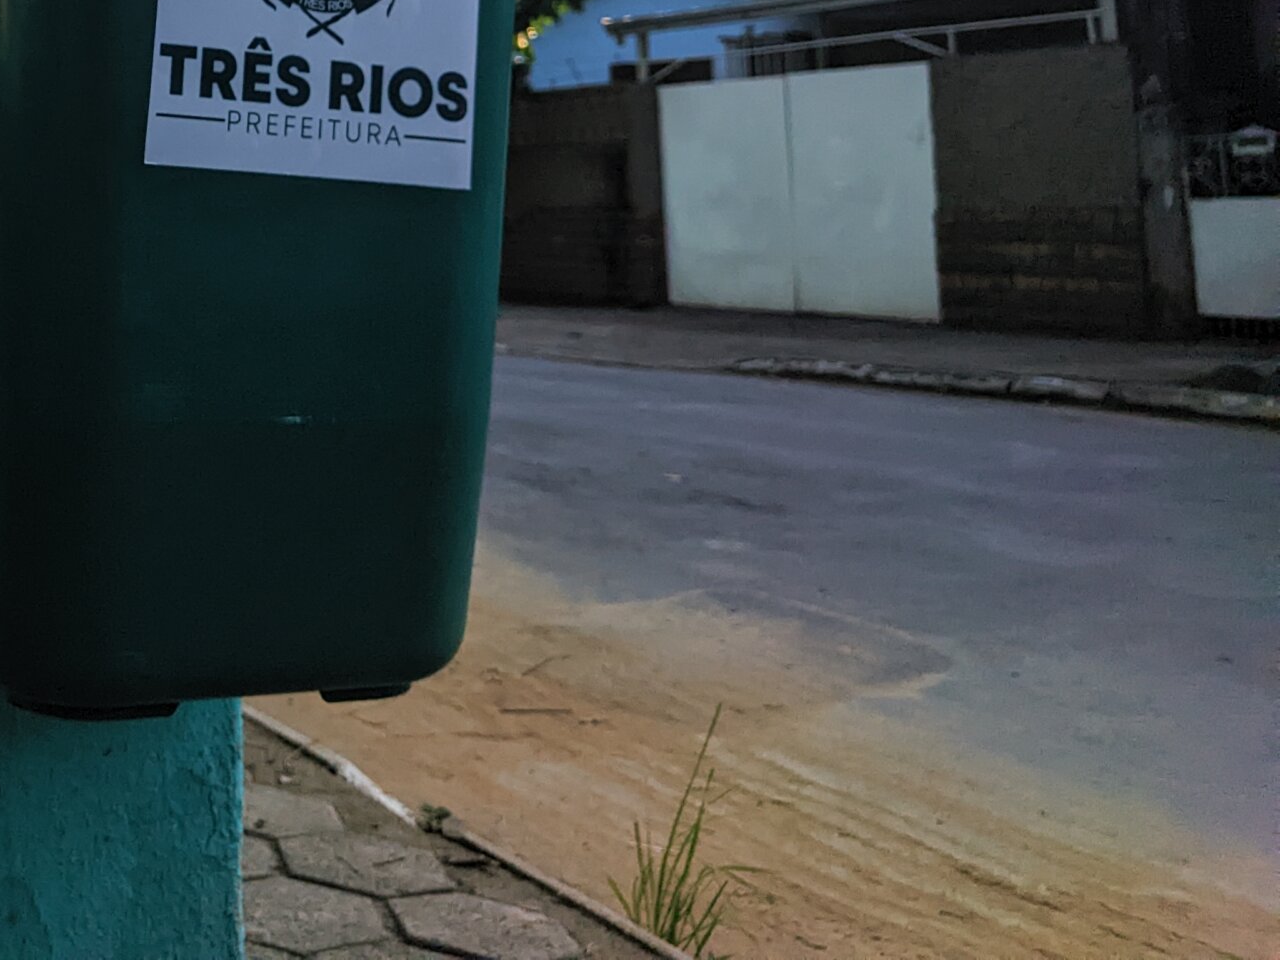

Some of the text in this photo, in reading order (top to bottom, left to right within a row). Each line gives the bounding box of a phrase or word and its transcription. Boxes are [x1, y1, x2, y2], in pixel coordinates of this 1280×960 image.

[160, 37, 468, 122] TRÊS RIOS
[227, 110, 401, 147] PREFEITURA
